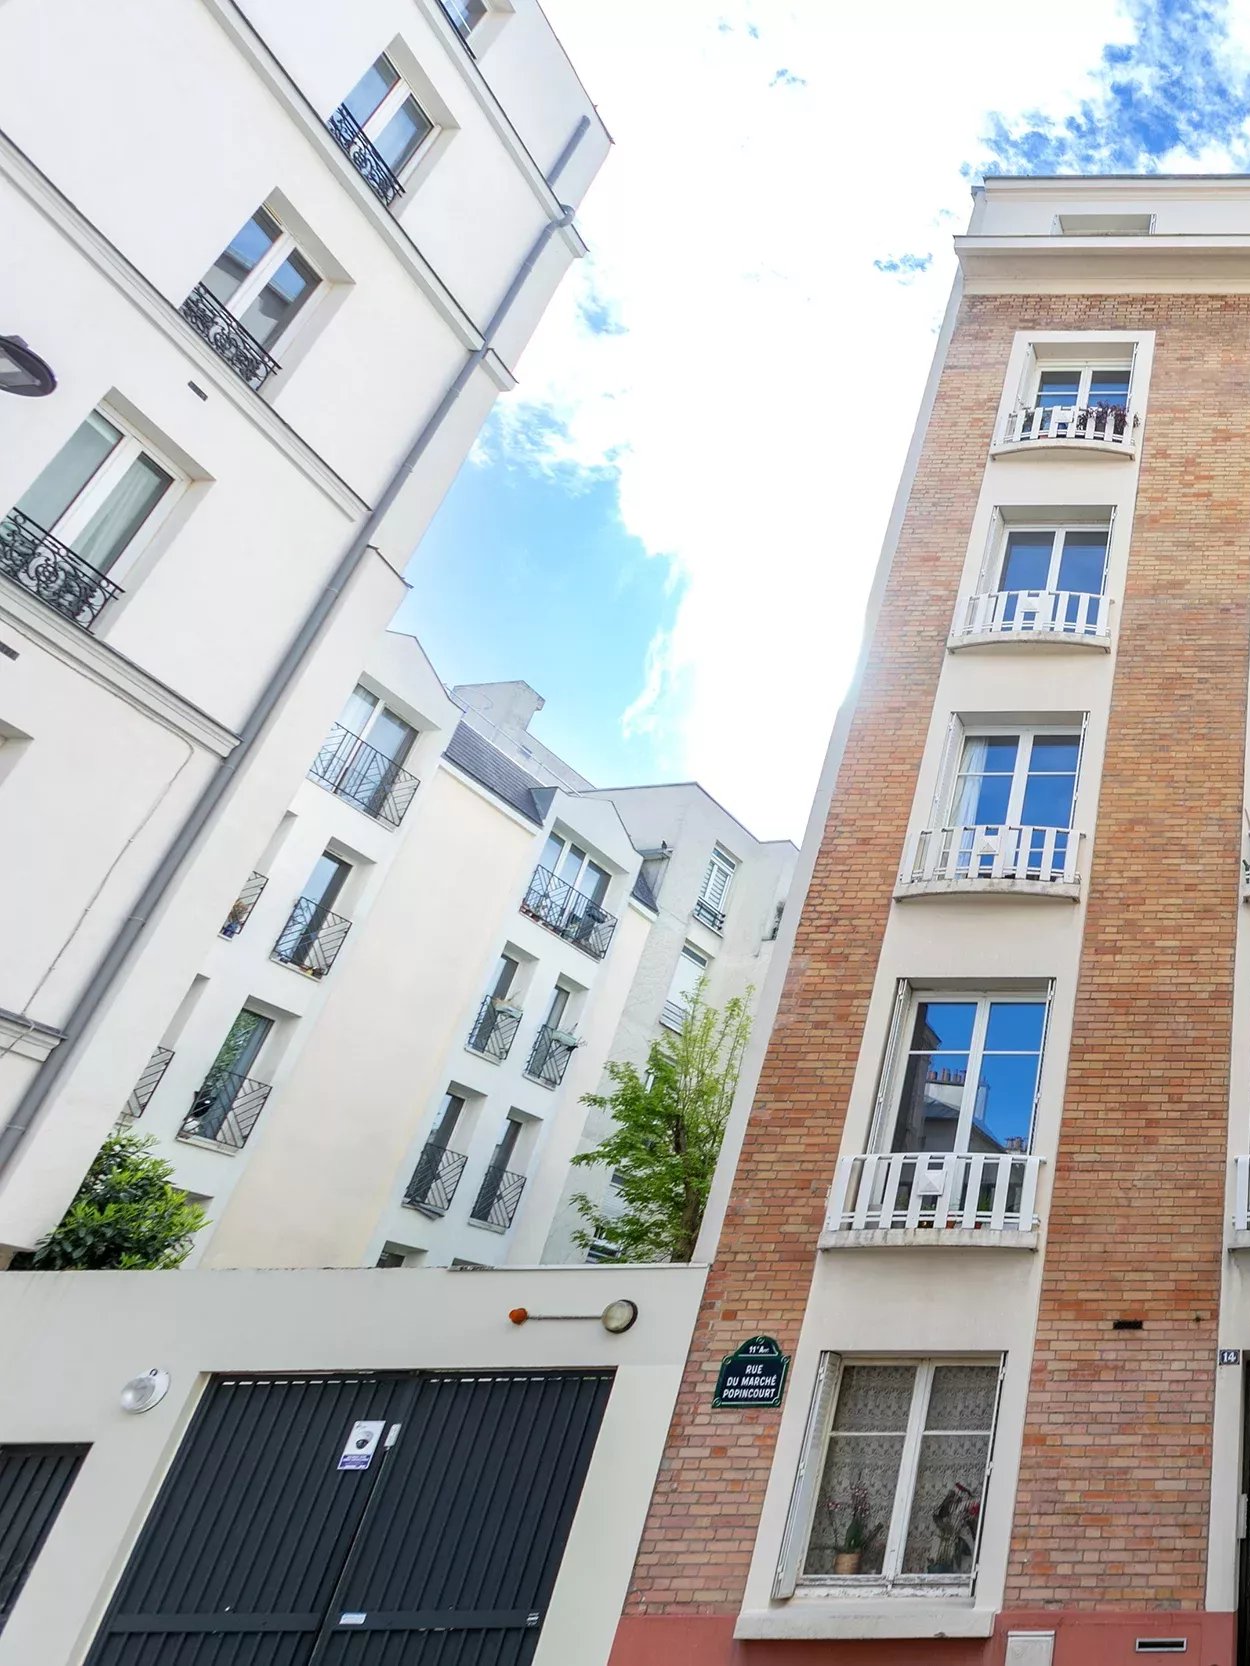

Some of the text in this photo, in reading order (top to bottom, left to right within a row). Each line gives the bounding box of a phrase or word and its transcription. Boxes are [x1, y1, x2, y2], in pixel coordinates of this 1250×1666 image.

[1223, 1351, 1237, 1363] 14
[745, 1364, 763, 1375] RUE
[726, 1375, 777, 1386] DU MARCHÉ
[722, 1388, 776, 1399] POPINCOURT
